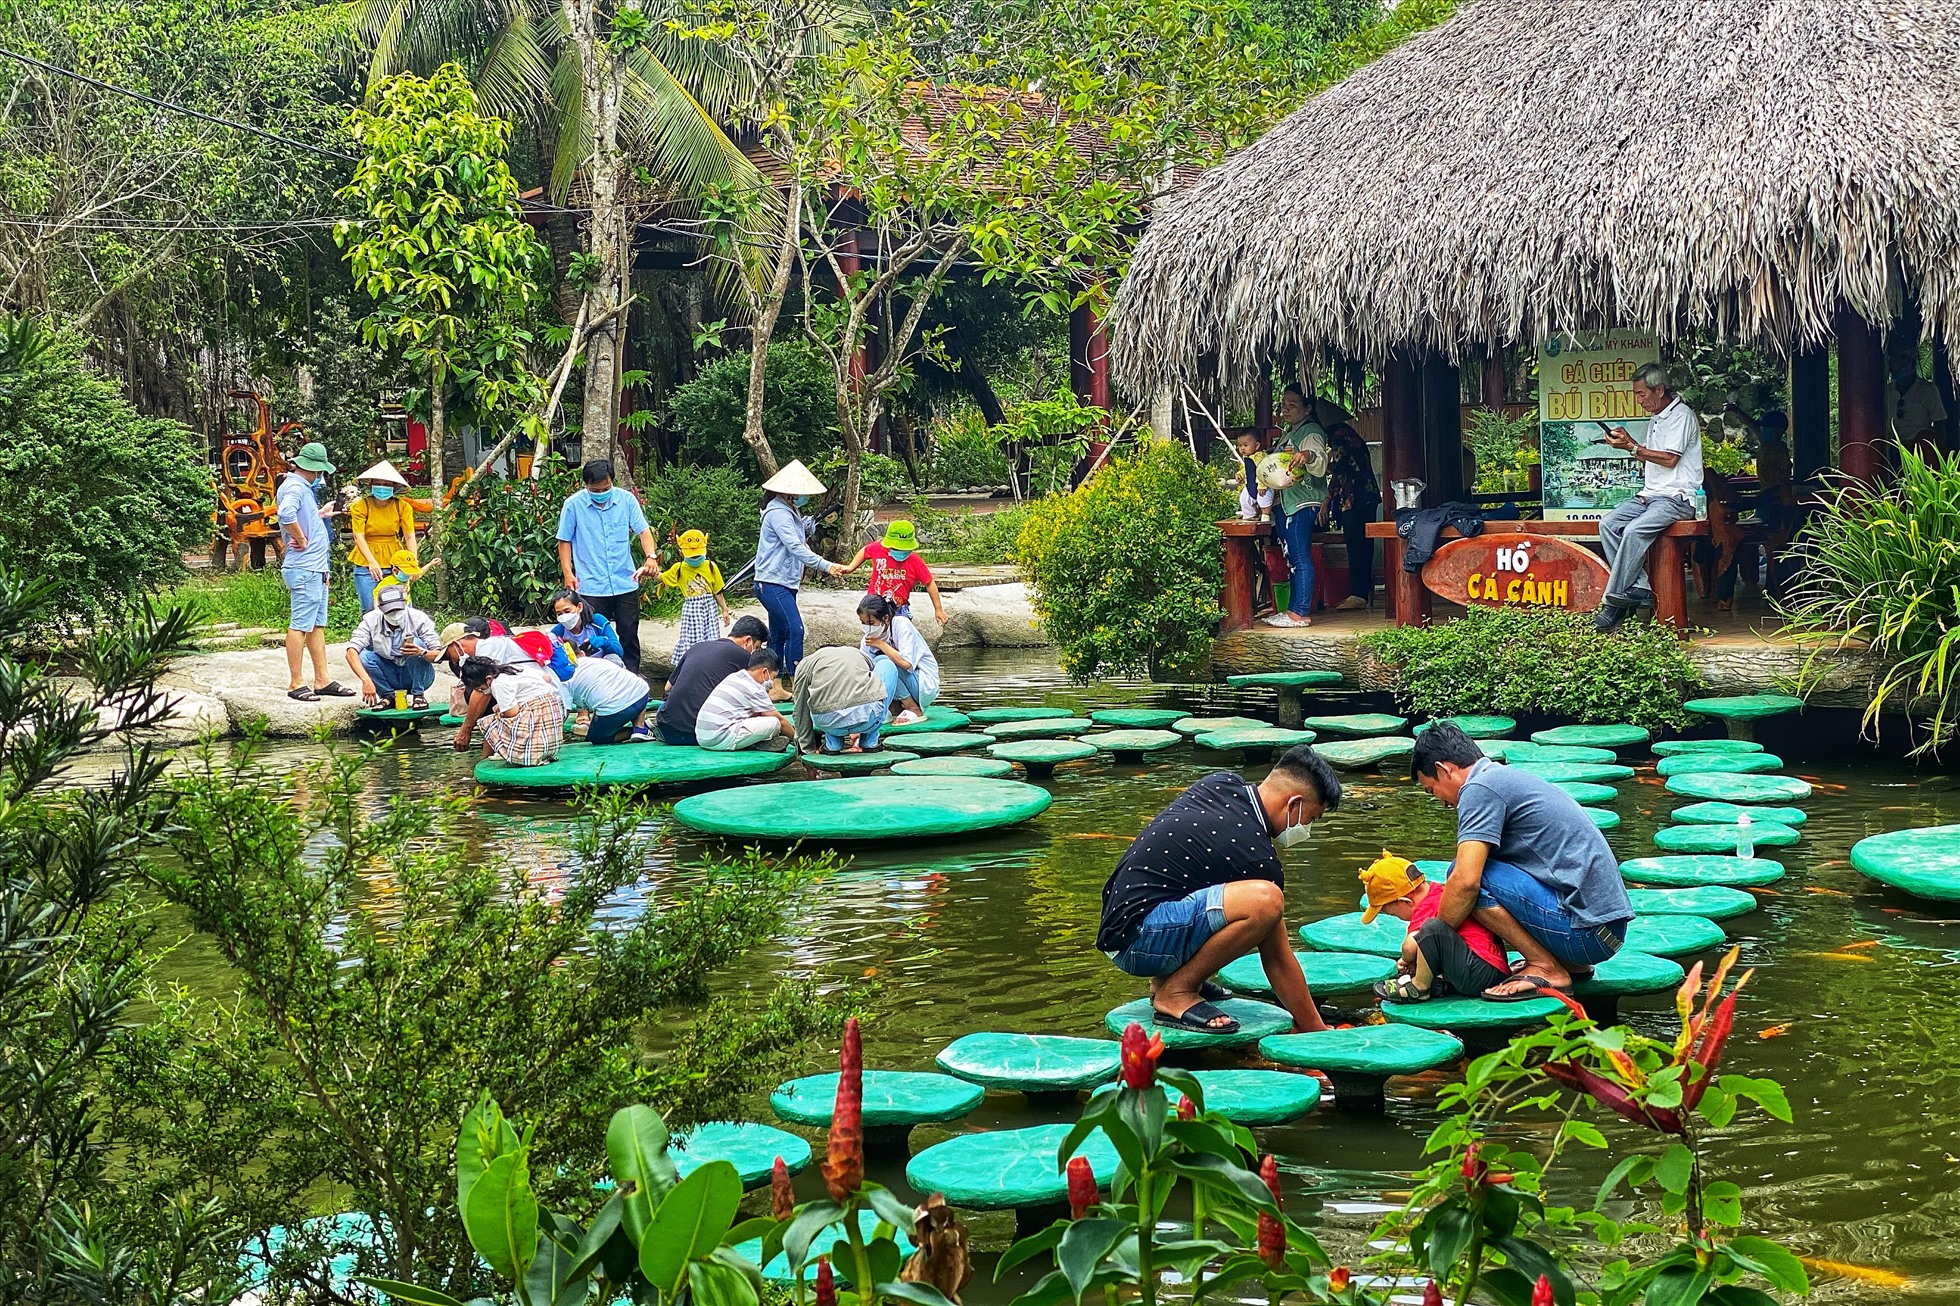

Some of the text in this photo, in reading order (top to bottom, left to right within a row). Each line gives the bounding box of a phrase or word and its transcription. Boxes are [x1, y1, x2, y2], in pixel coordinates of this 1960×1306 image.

[1561, 358, 1637, 384] CÁ CHÉP
[1548, 387, 1582, 419] BÚ
[1496, 541, 1531, 573] HỒ
[1467, 572, 1568, 606] CÁ CẢNH
